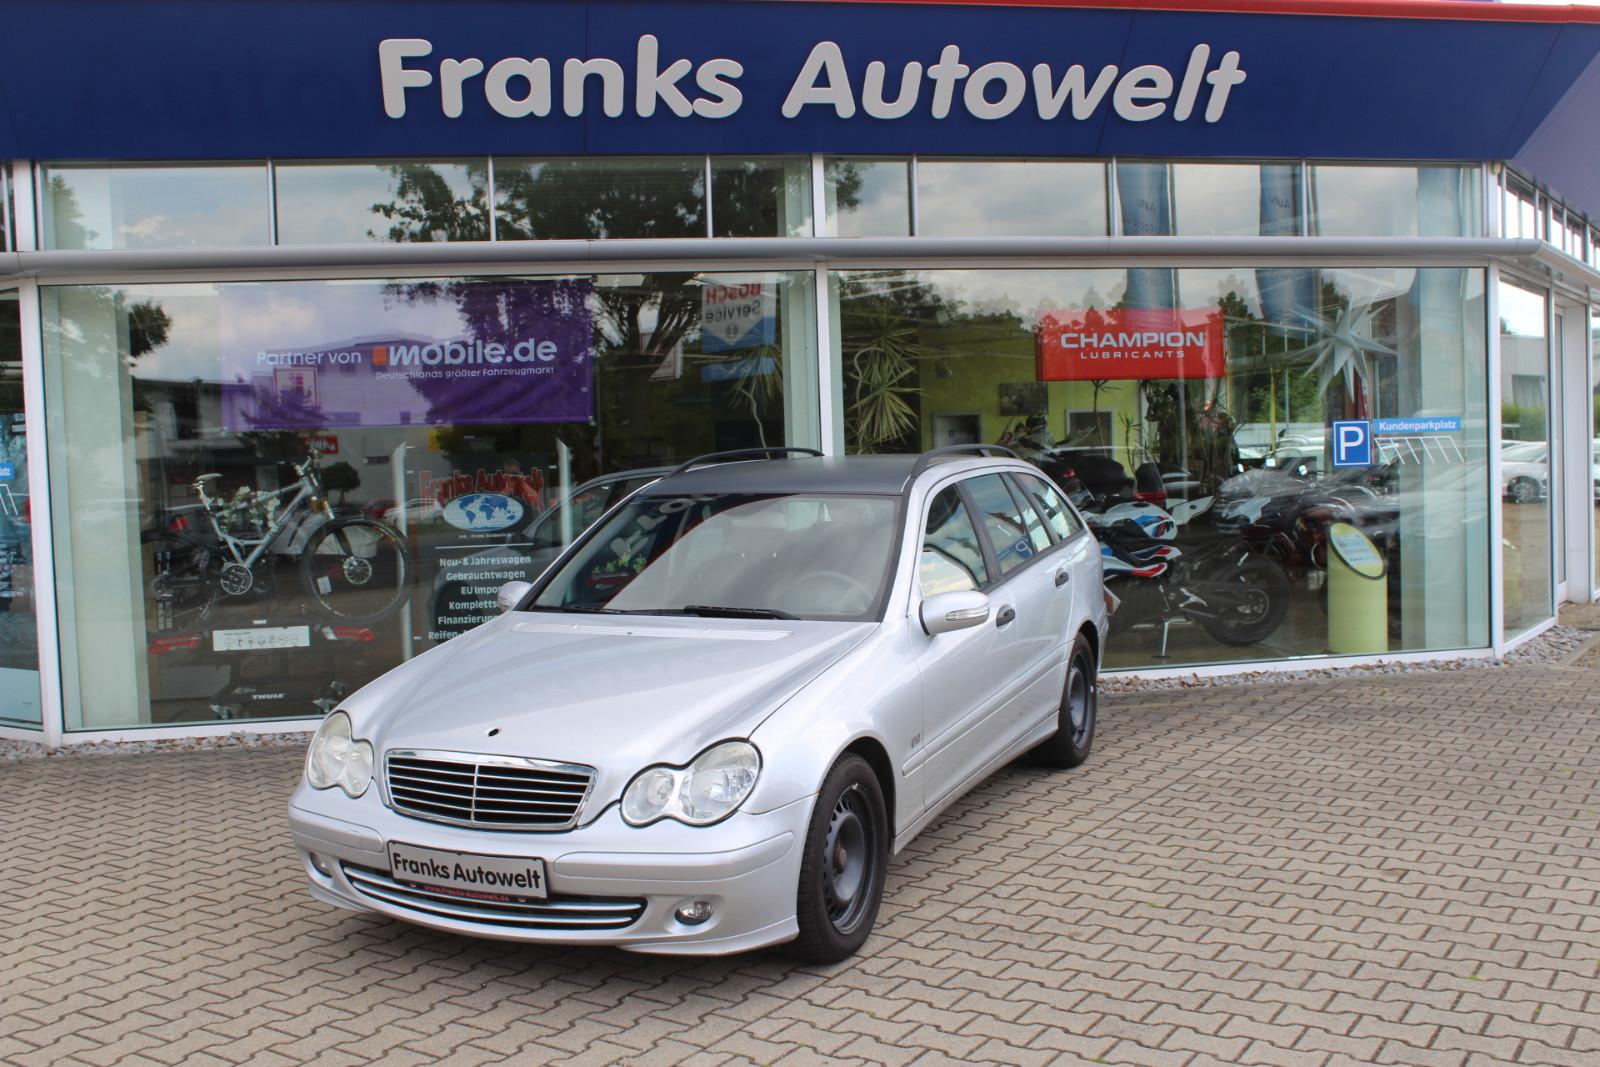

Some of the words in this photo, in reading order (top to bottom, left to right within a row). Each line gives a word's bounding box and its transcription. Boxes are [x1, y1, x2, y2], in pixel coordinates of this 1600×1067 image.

[379, 34, 744, 118] Franks
[781, 41, 1247, 123] Autowelt
[1061, 332, 1205, 349] CHAMPION
[256, 350, 323, 366] Partner
[328, 350, 362, 364] von
[389, 338, 558, 367] mobile.de
[1080, 350, 1185, 360] LUBRICANTS
[376, 369, 443, 380] Deutschlands
[445, 368, 480, 379] größter
[482, 366, 555, 378] Fahrzeugmarkt
[1379, 419, 1457, 432] Kundenparkplatz
[1340, 426, 1365, 460] P
[470, 555, 532, 568] Jahreswagen
[446, 569, 526, 581] Gebrauchtwagen
[461, 586, 473, 595] EU
[448, 600, 499, 611] Kompletts
[393, 852, 450, 879] Franks
[453, 863, 541, 889] Autowelt
